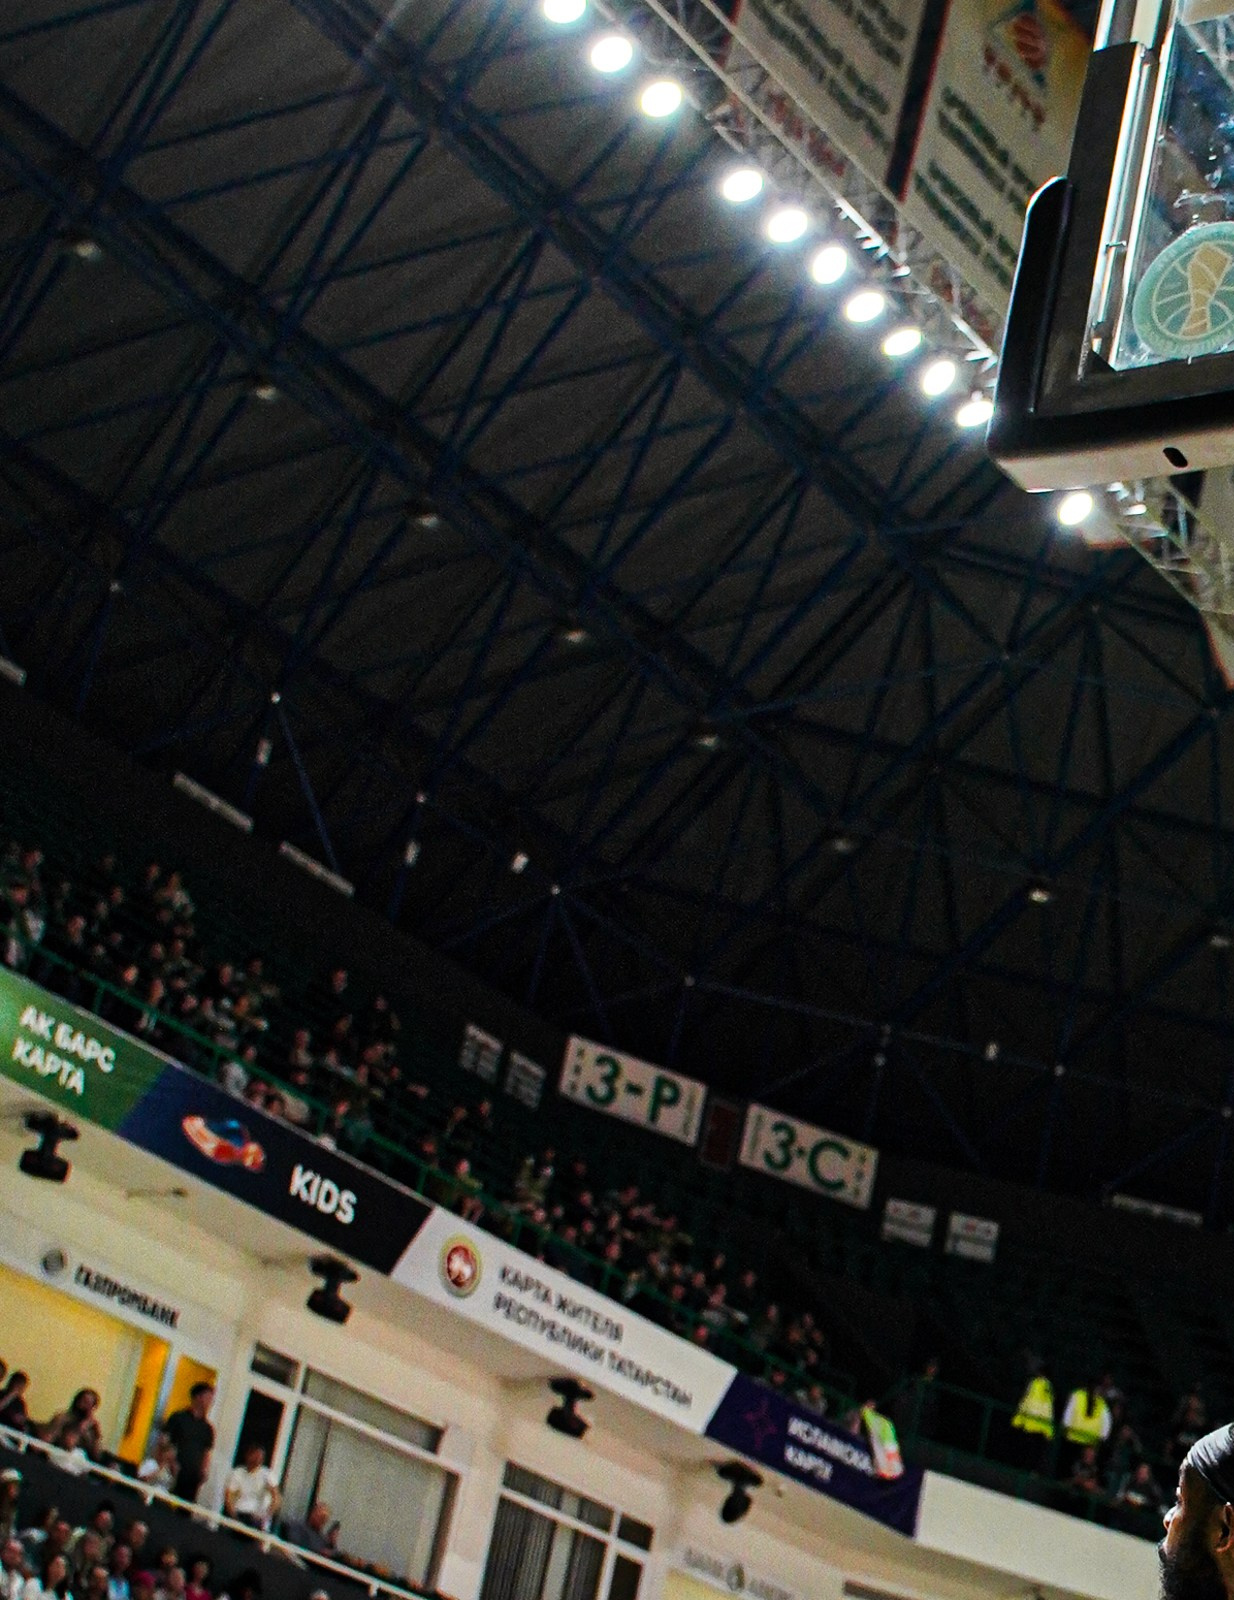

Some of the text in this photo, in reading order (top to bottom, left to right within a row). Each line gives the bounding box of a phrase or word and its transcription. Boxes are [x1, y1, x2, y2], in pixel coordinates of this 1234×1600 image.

[11, 1036, 85, 1097] КАРТА
[20, 1004, 116, 1074] АК БАРС
[289, 1163, 358, 1225] KIDS
